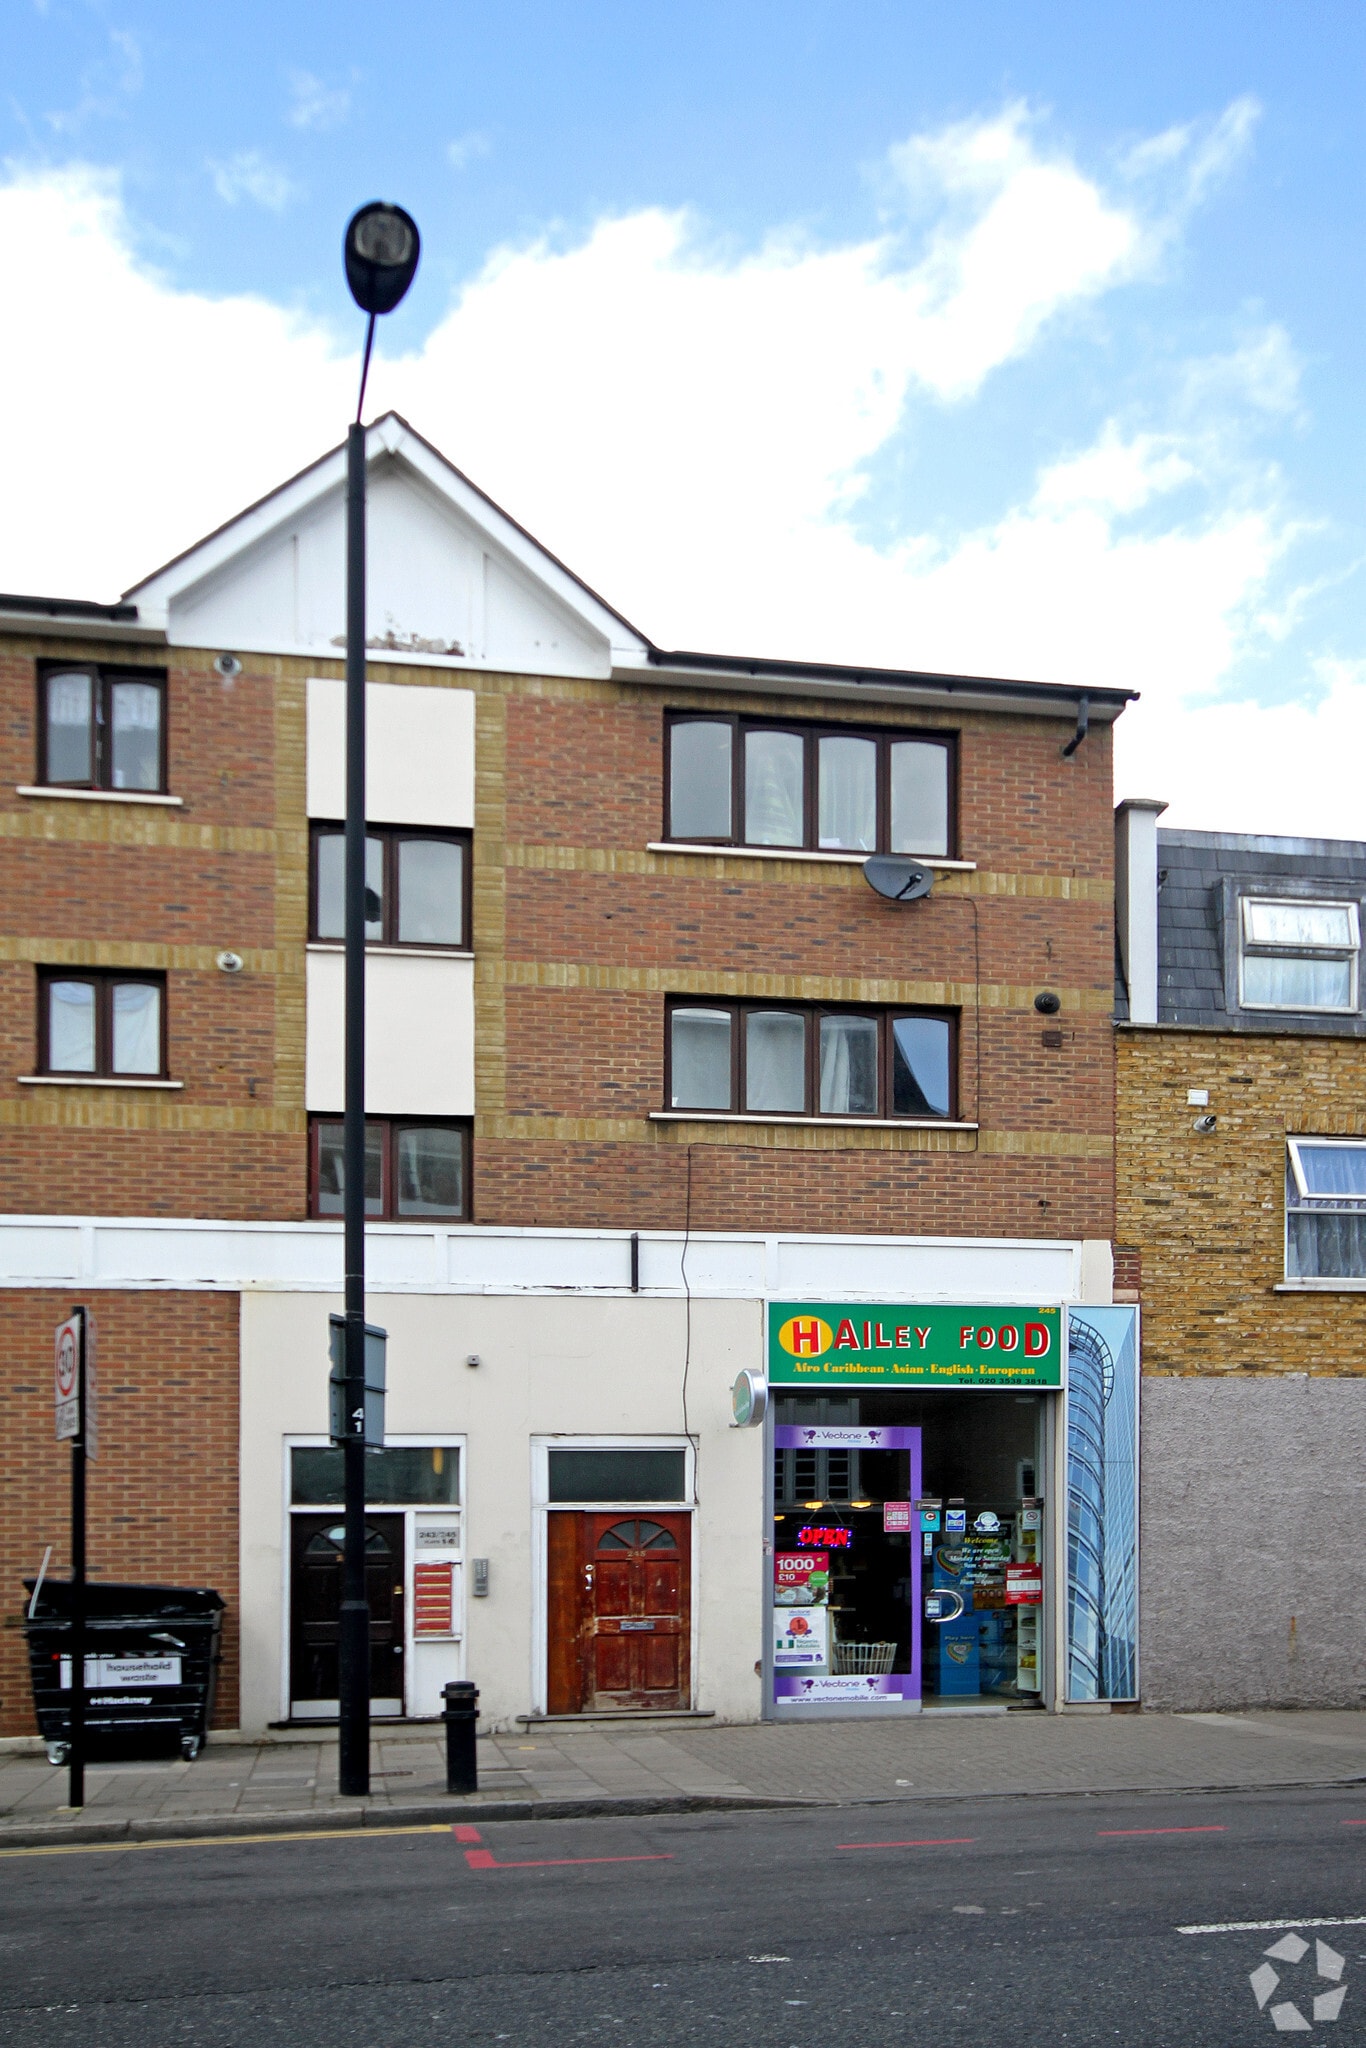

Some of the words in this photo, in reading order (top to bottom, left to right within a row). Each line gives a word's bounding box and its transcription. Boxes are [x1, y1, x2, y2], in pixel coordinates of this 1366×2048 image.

[792, 1319, 931, 1355] HAILEY
[959, 1322, 1051, 1358] FOOD
[793, 1362, 820, 1372] Afro
[823, 1362, 885, 1373] Caribbean
[891, 1363, 924, 1374] Asian
[930, 1364, 974, 1376] English
[980, 1364, 1035, 1377] European
[822, 1431, 861, 1440] Vectone
[800, 1528, 849, 1545] OPEN
[963, 1536, 998, 1544] Welcome
[776, 1558, 815, 1571] 1000
[778, 1573, 796, 1581] £10
[966, 1572, 988, 1580] Sunday
[106, 1661, 172, 1672] household
[121, 1674, 158, 1682] waste
[819, 1680, 860, 1688] Vectone
